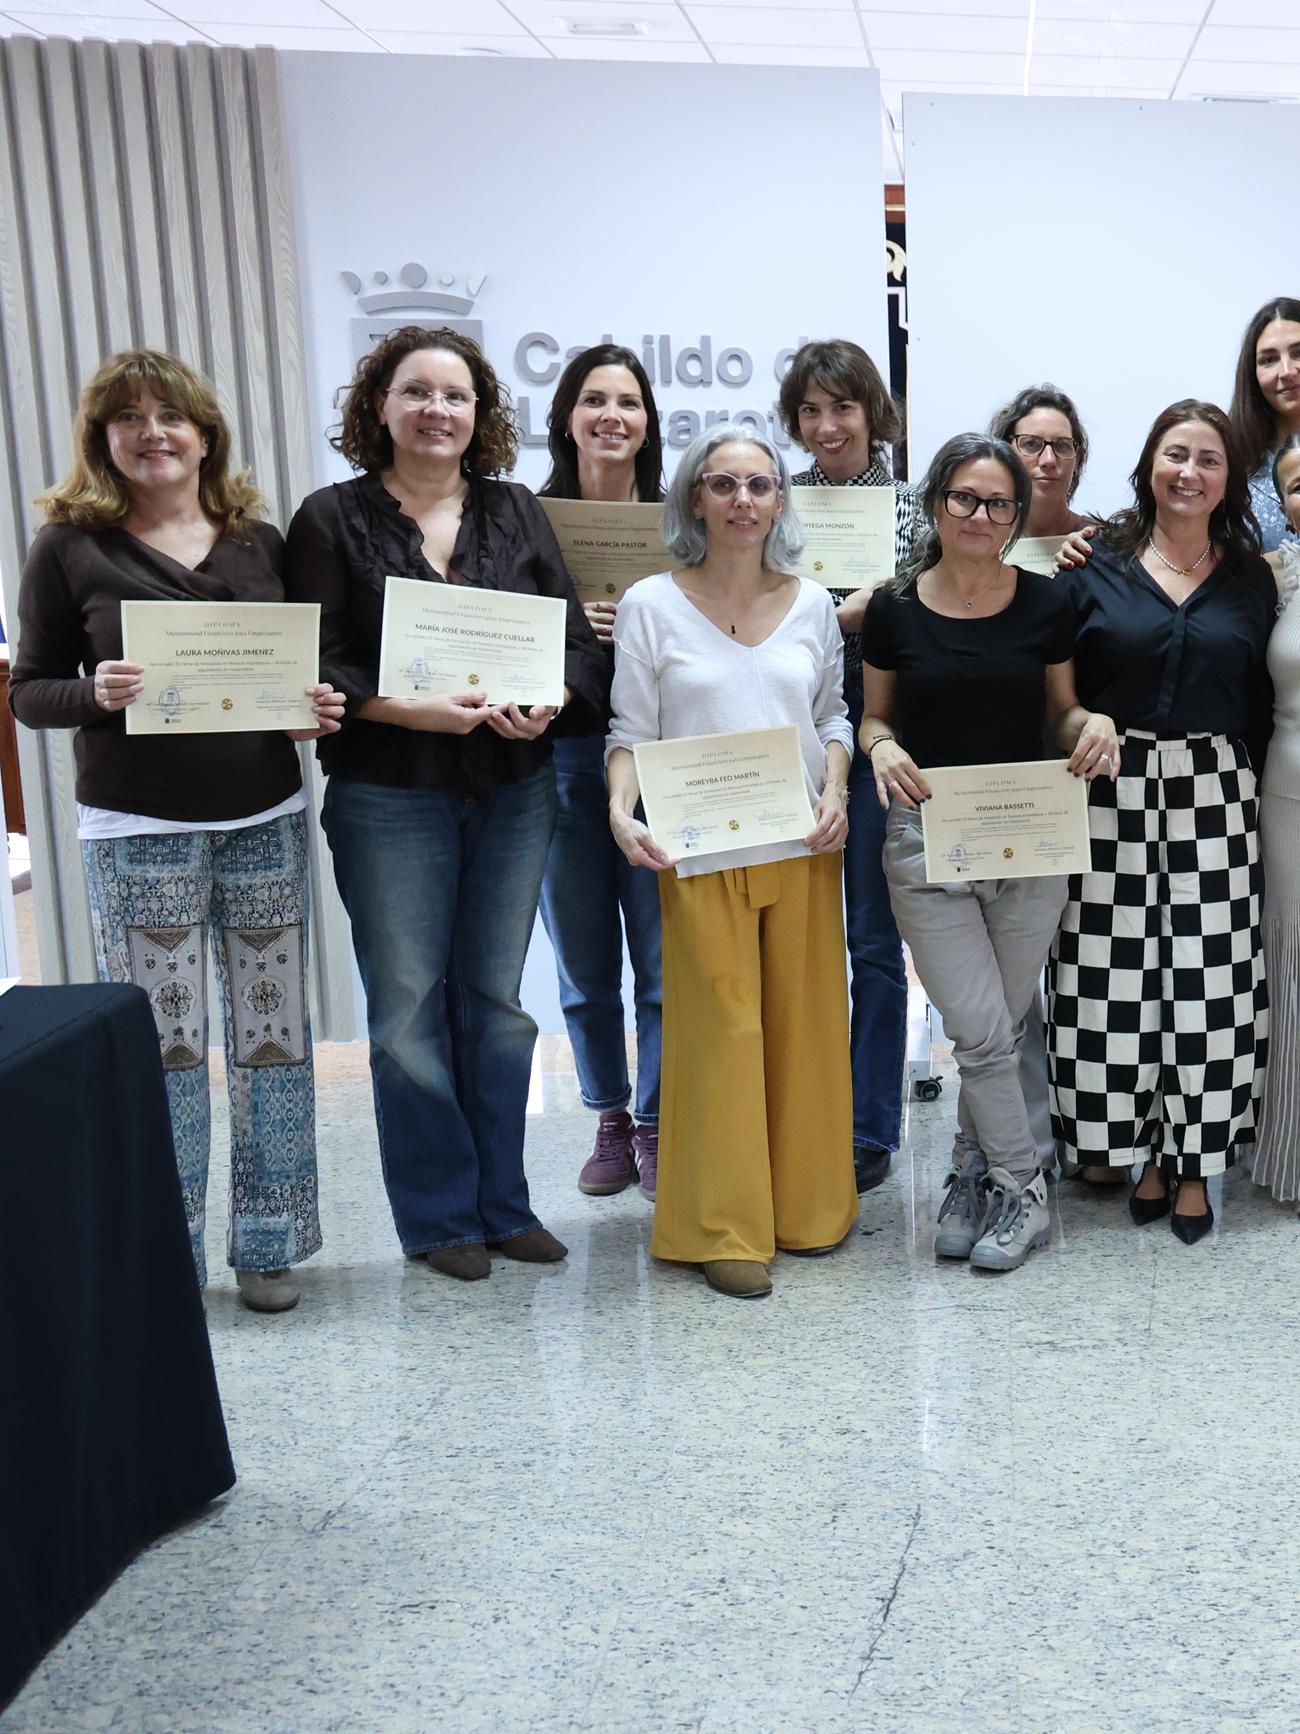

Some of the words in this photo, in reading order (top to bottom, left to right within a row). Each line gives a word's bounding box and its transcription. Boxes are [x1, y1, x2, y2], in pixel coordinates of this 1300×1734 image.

[514, 331, 753, 387] Cildo
[595, 540, 620, 548] GARCÍA
[415, 624, 440, 632] MARÍA
[441, 625, 458, 634] JOSÉ
[460, 628, 502, 639] RODRÍGUEZ
[504, 633, 535, 643] CUELLAR
[176, 649, 202, 657] LAURA
[203, 648, 240, 656] MOÑIVAS
[242, 648, 274, 656] JIMENEZ
[685, 777, 718, 788] MOREYBA
[720, 775, 733, 783] FEO
[734, 771, 760, 781] MARTÍN
[975, 804, 1003, 812] VIVIANA
[1004, 802, 1035, 811] BASSETTI
